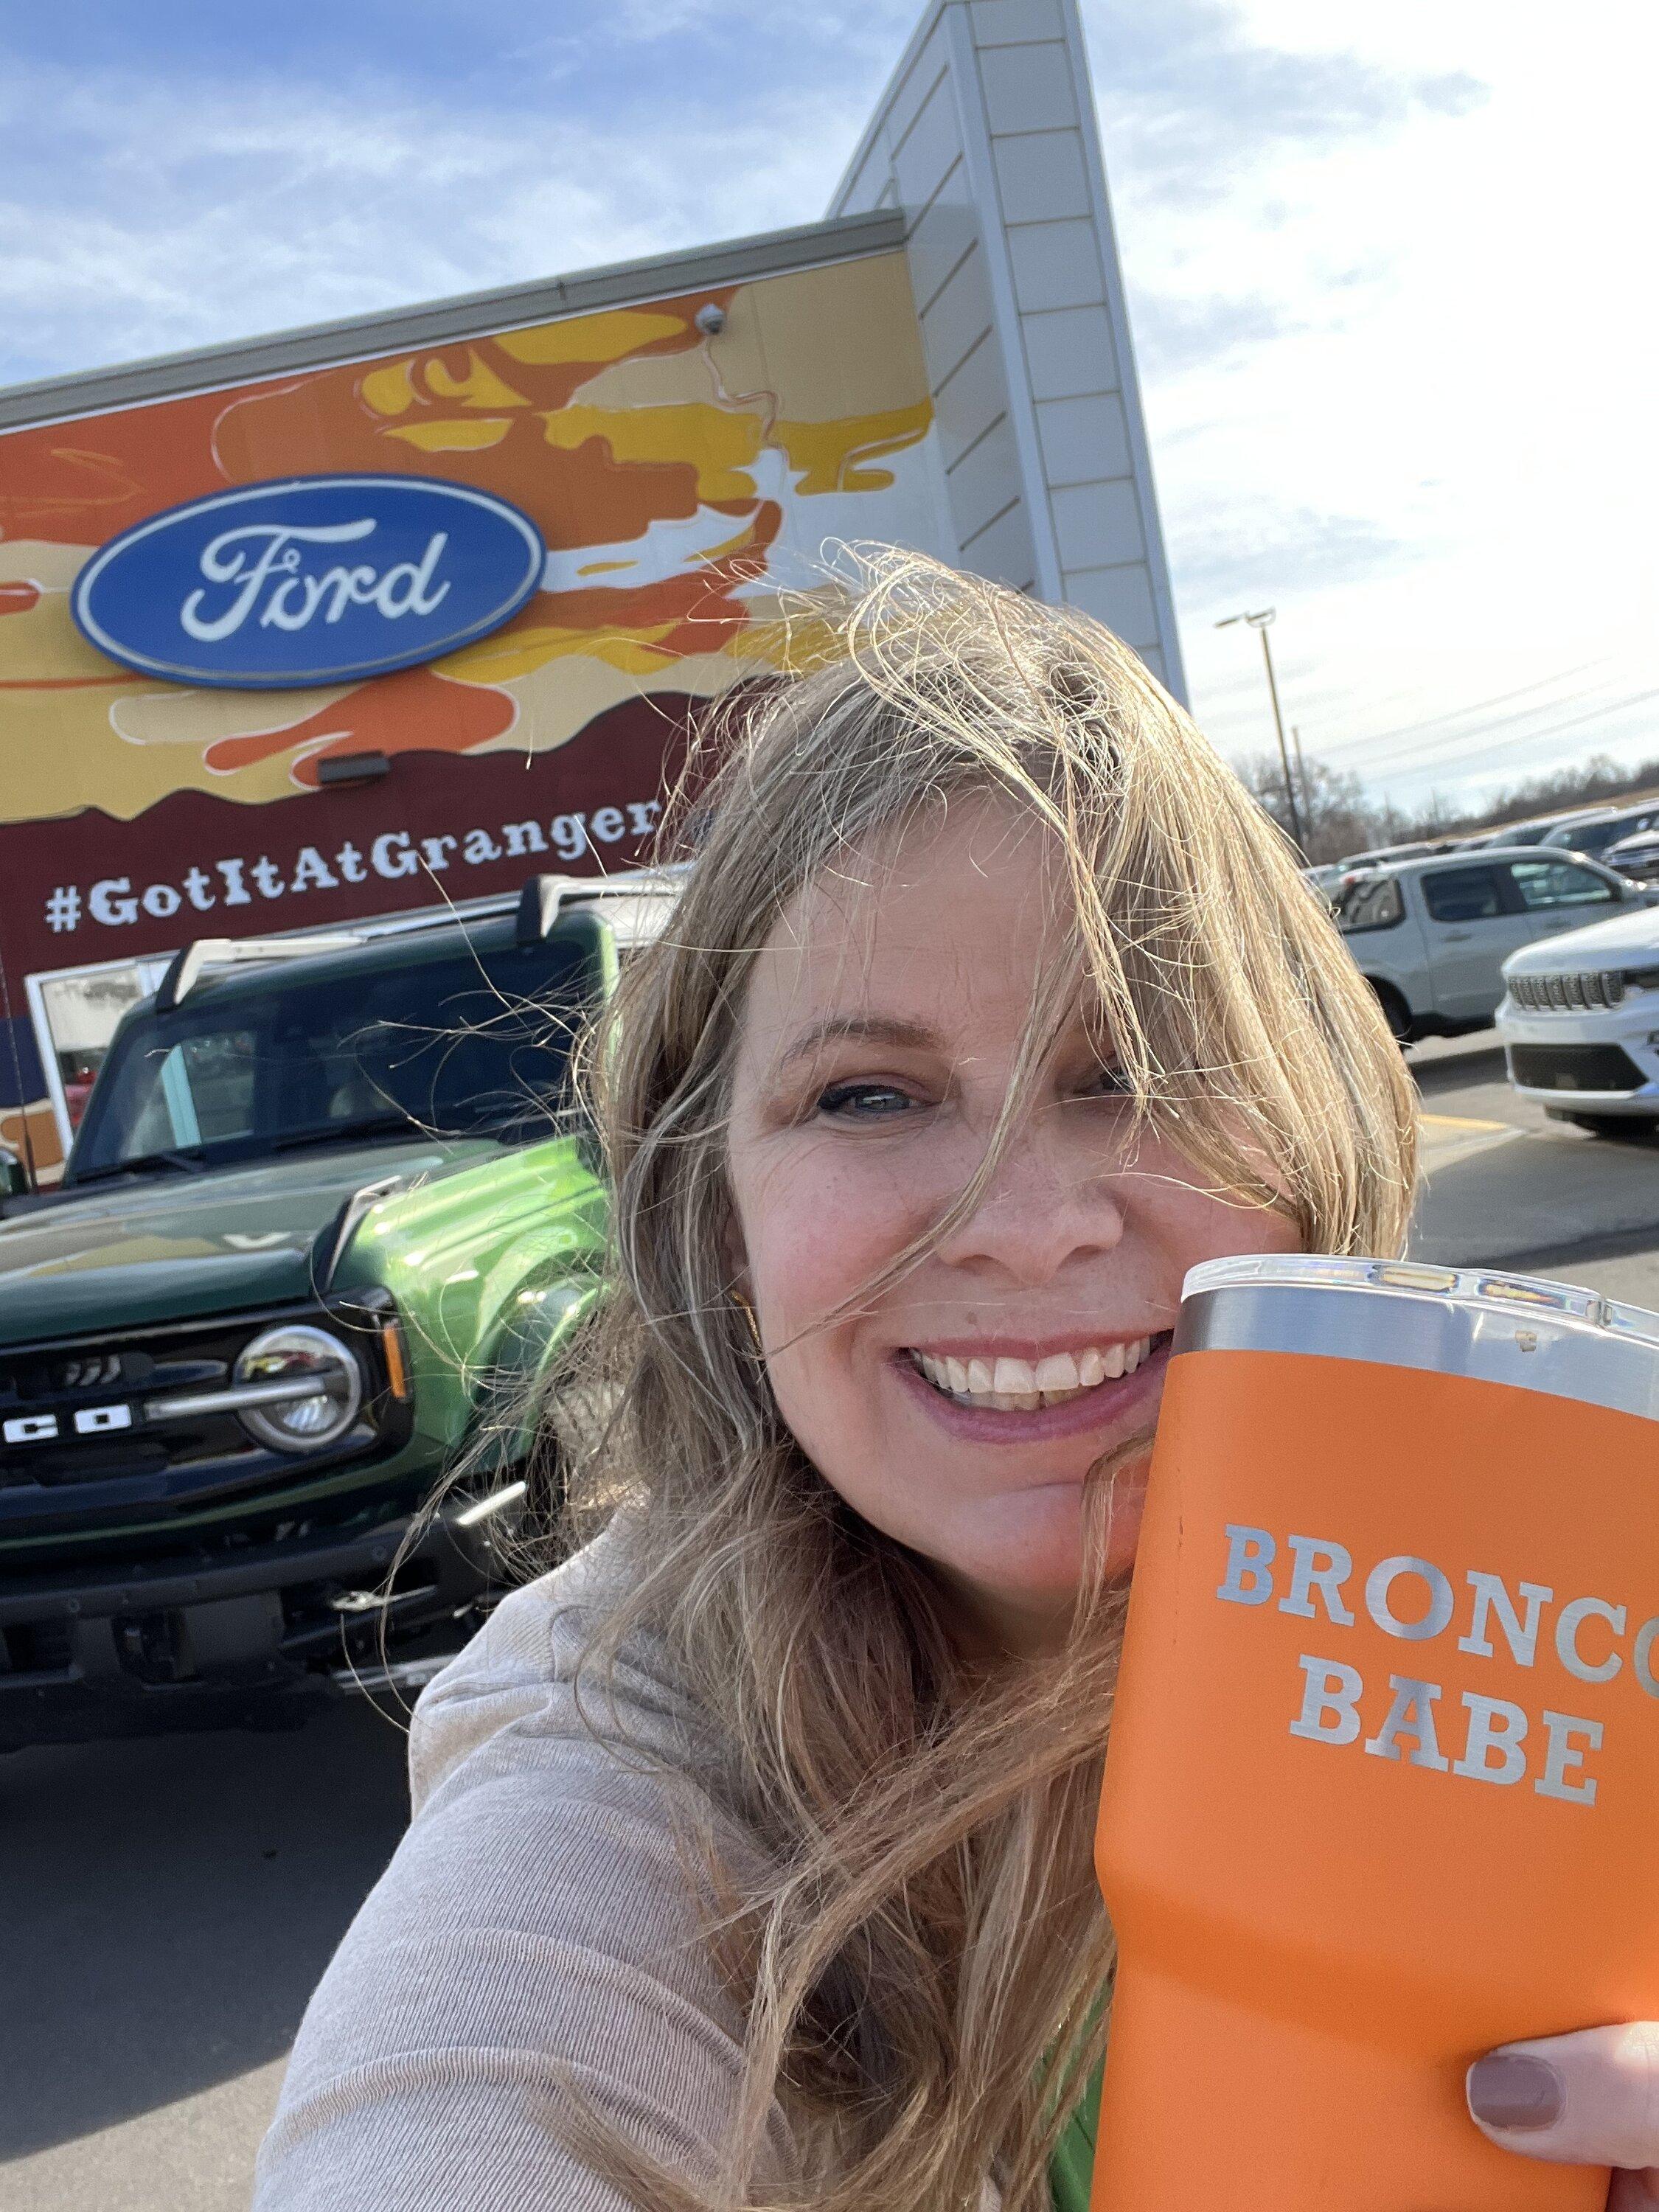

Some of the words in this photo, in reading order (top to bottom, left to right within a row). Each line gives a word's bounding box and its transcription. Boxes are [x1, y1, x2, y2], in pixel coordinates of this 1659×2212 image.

[181, 518, 451, 642] Ford
[45, 799, 661, 933] #GotItAtGranger
[1288, 1654, 1604, 1806] BABE
